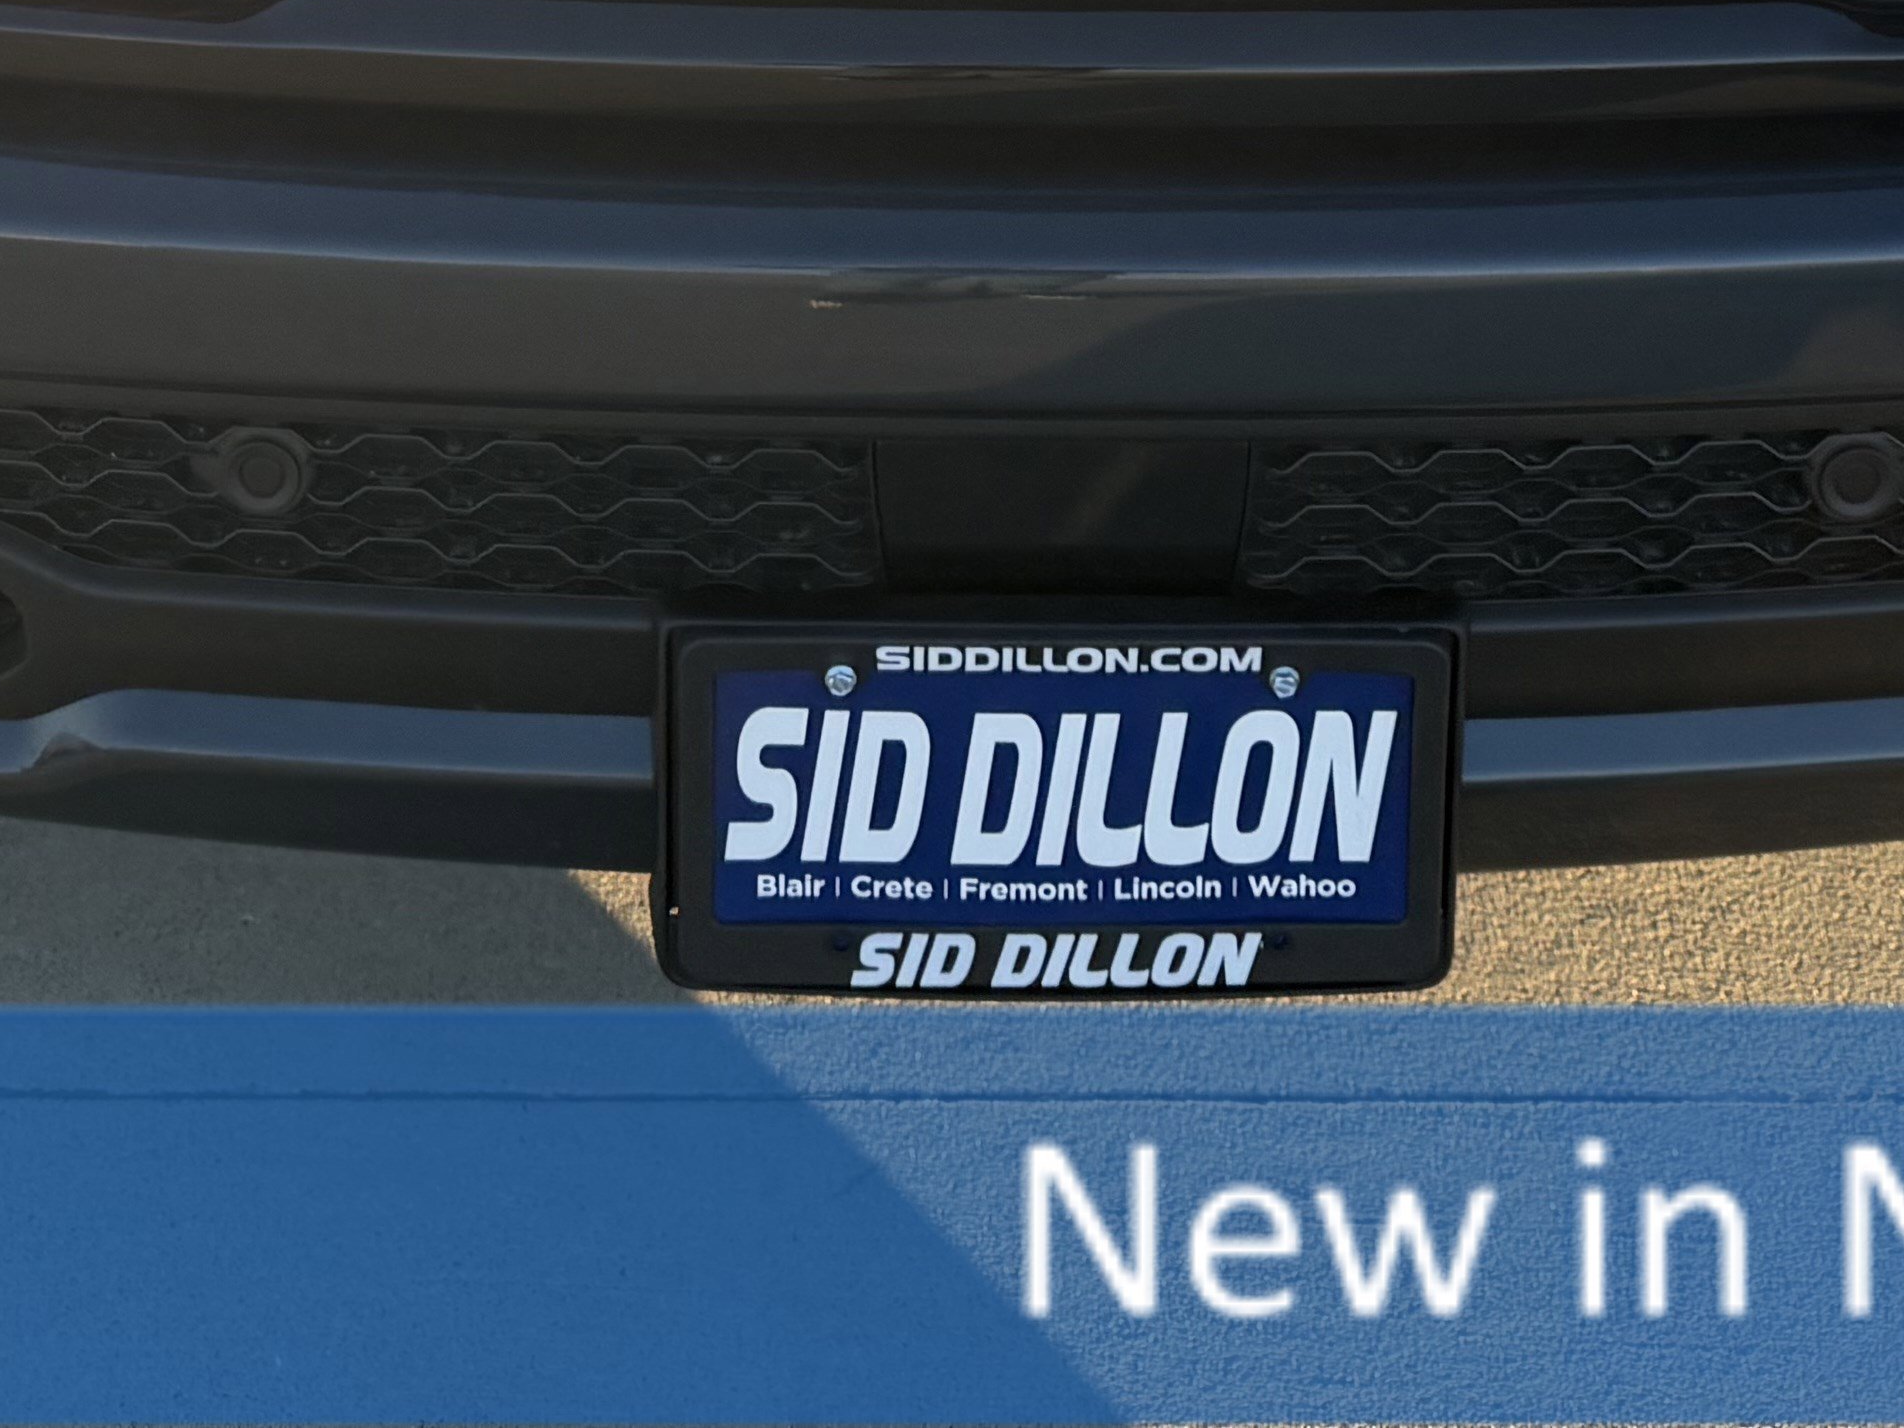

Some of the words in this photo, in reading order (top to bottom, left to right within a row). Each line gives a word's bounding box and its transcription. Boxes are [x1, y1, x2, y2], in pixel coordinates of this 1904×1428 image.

[874, 645, 1264, 673] SIDDILLON.COM
[723, 706, 932, 864] SID
[949, 709, 1398, 867] DILLON
[756, 873, 825, 898] Blair
[850, 874, 934, 900] Crete
[959, 877, 1089, 902] Fremont
[1113, 874, 1223, 901] Lincoln
[1247, 874, 1357, 898] Wahoo
[849, 932, 977, 988] SID
[989, 931, 1263, 988] DILLON
